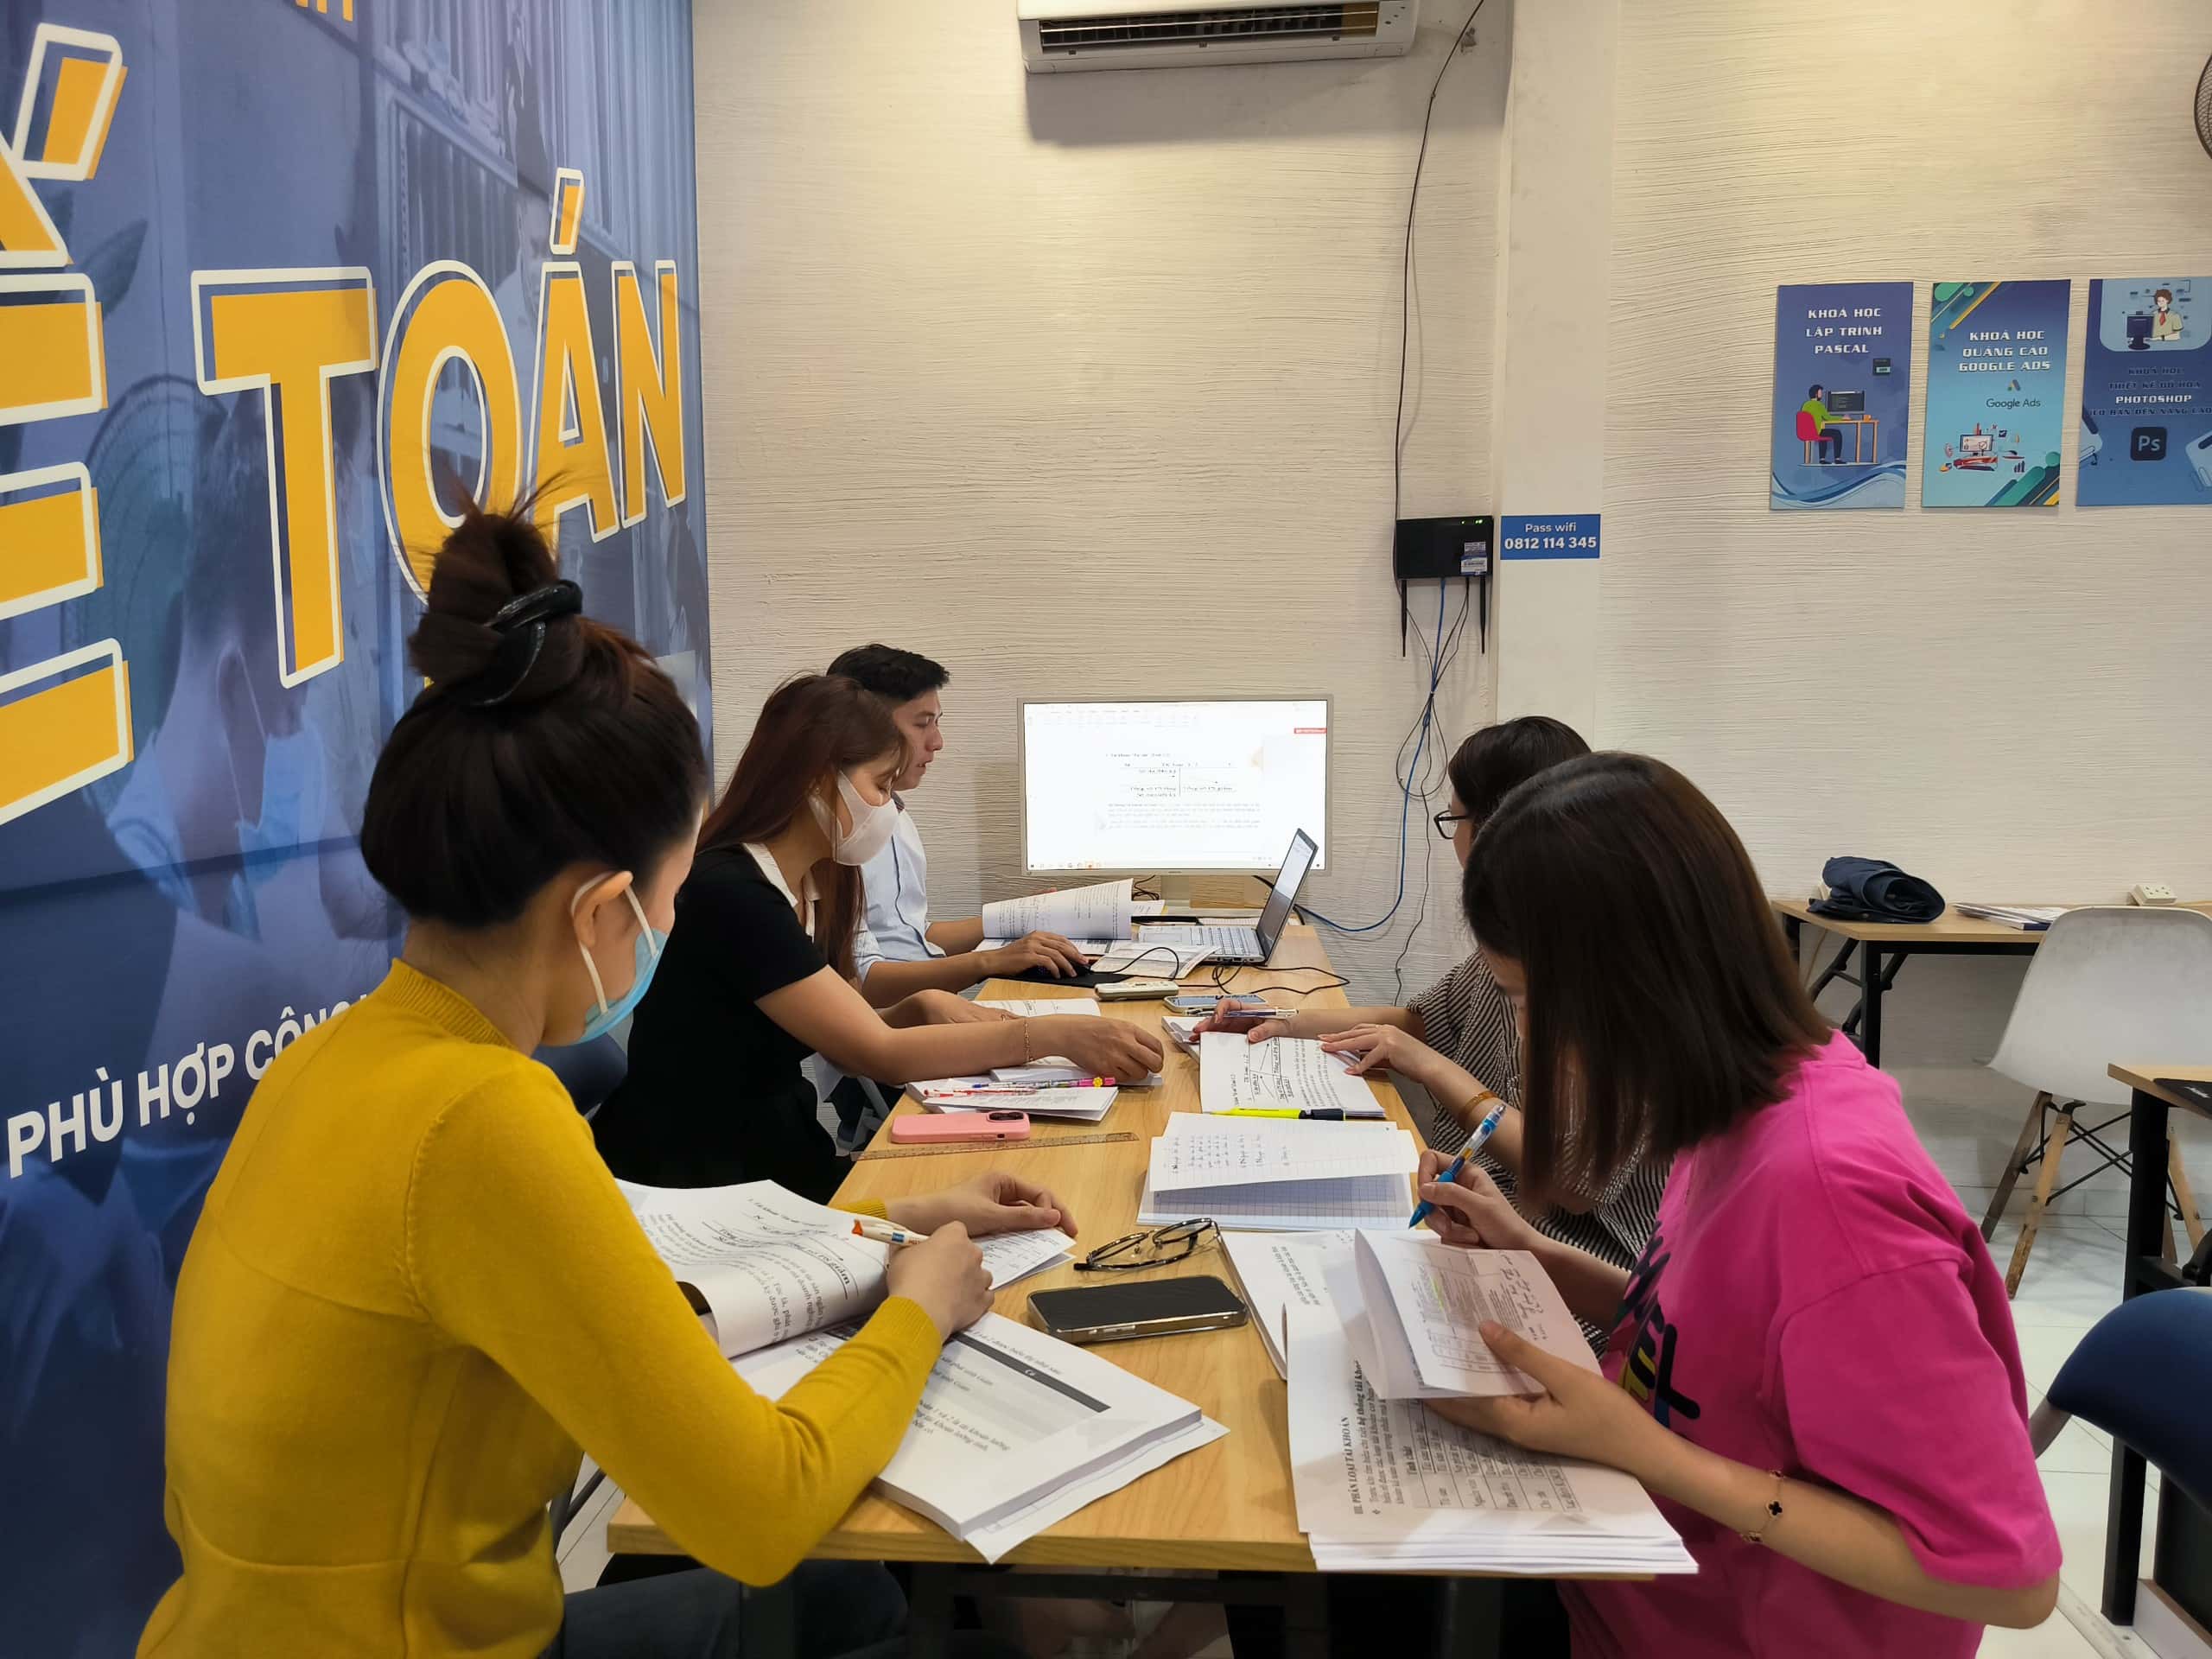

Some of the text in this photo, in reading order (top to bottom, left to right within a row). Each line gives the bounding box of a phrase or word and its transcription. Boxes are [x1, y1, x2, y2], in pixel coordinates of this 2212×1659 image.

[1815, 344, 1870, 354] PASCAL
[1959, 360, 2051, 372] GOOGLE ADS
[1986, 397, 2041, 410] Google Ads
[2115, 394, 2192, 404] PHOTOSHOP
[2138, 435, 2161, 452] Ps
[1525, 522, 1577, 533] Pass wifi
[1504, 536, 1597, 550] 0812 114 345
[7, 1067, 124, 1179] PHÙ
[138, 1042, 234, 1125] HỢP
